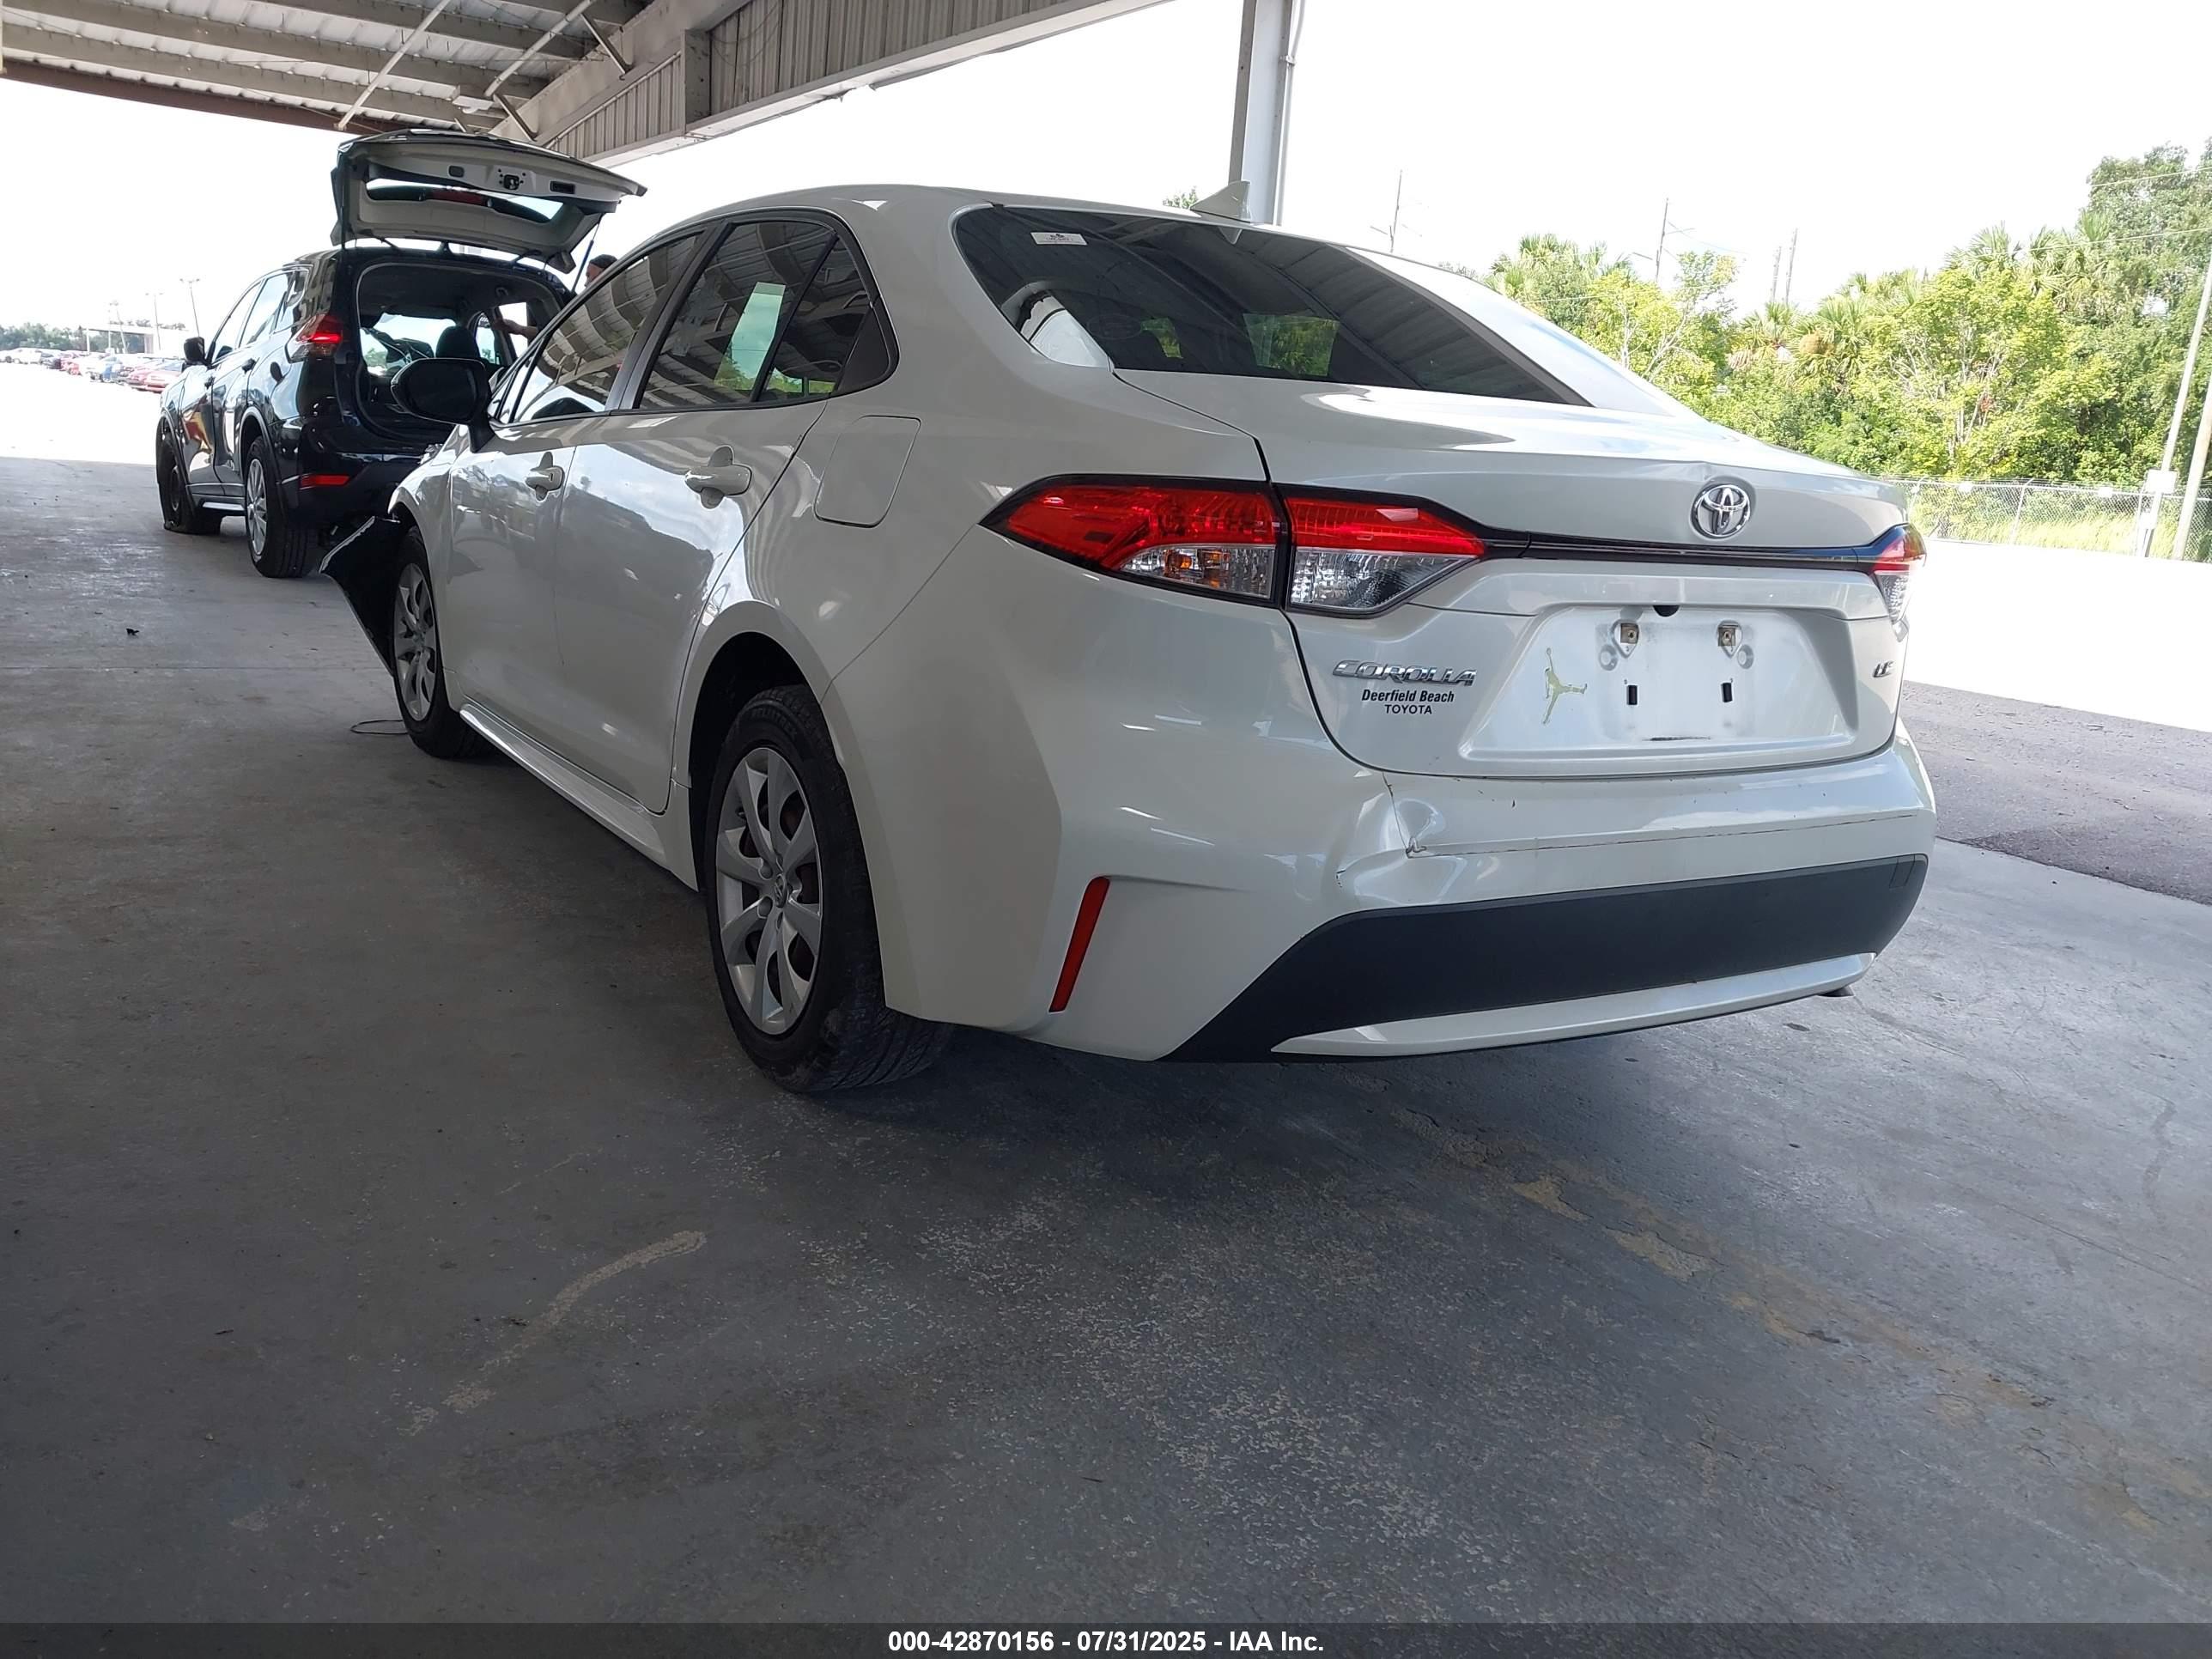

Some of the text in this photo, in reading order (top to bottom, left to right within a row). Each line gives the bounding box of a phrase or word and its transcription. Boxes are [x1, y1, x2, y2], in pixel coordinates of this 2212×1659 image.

[1332, 659, 1477, 686] COROLLA
[1361, 689, 1455, 703] Deerfield Beach
[1384, 703, 1432, 715] TOYOTA
